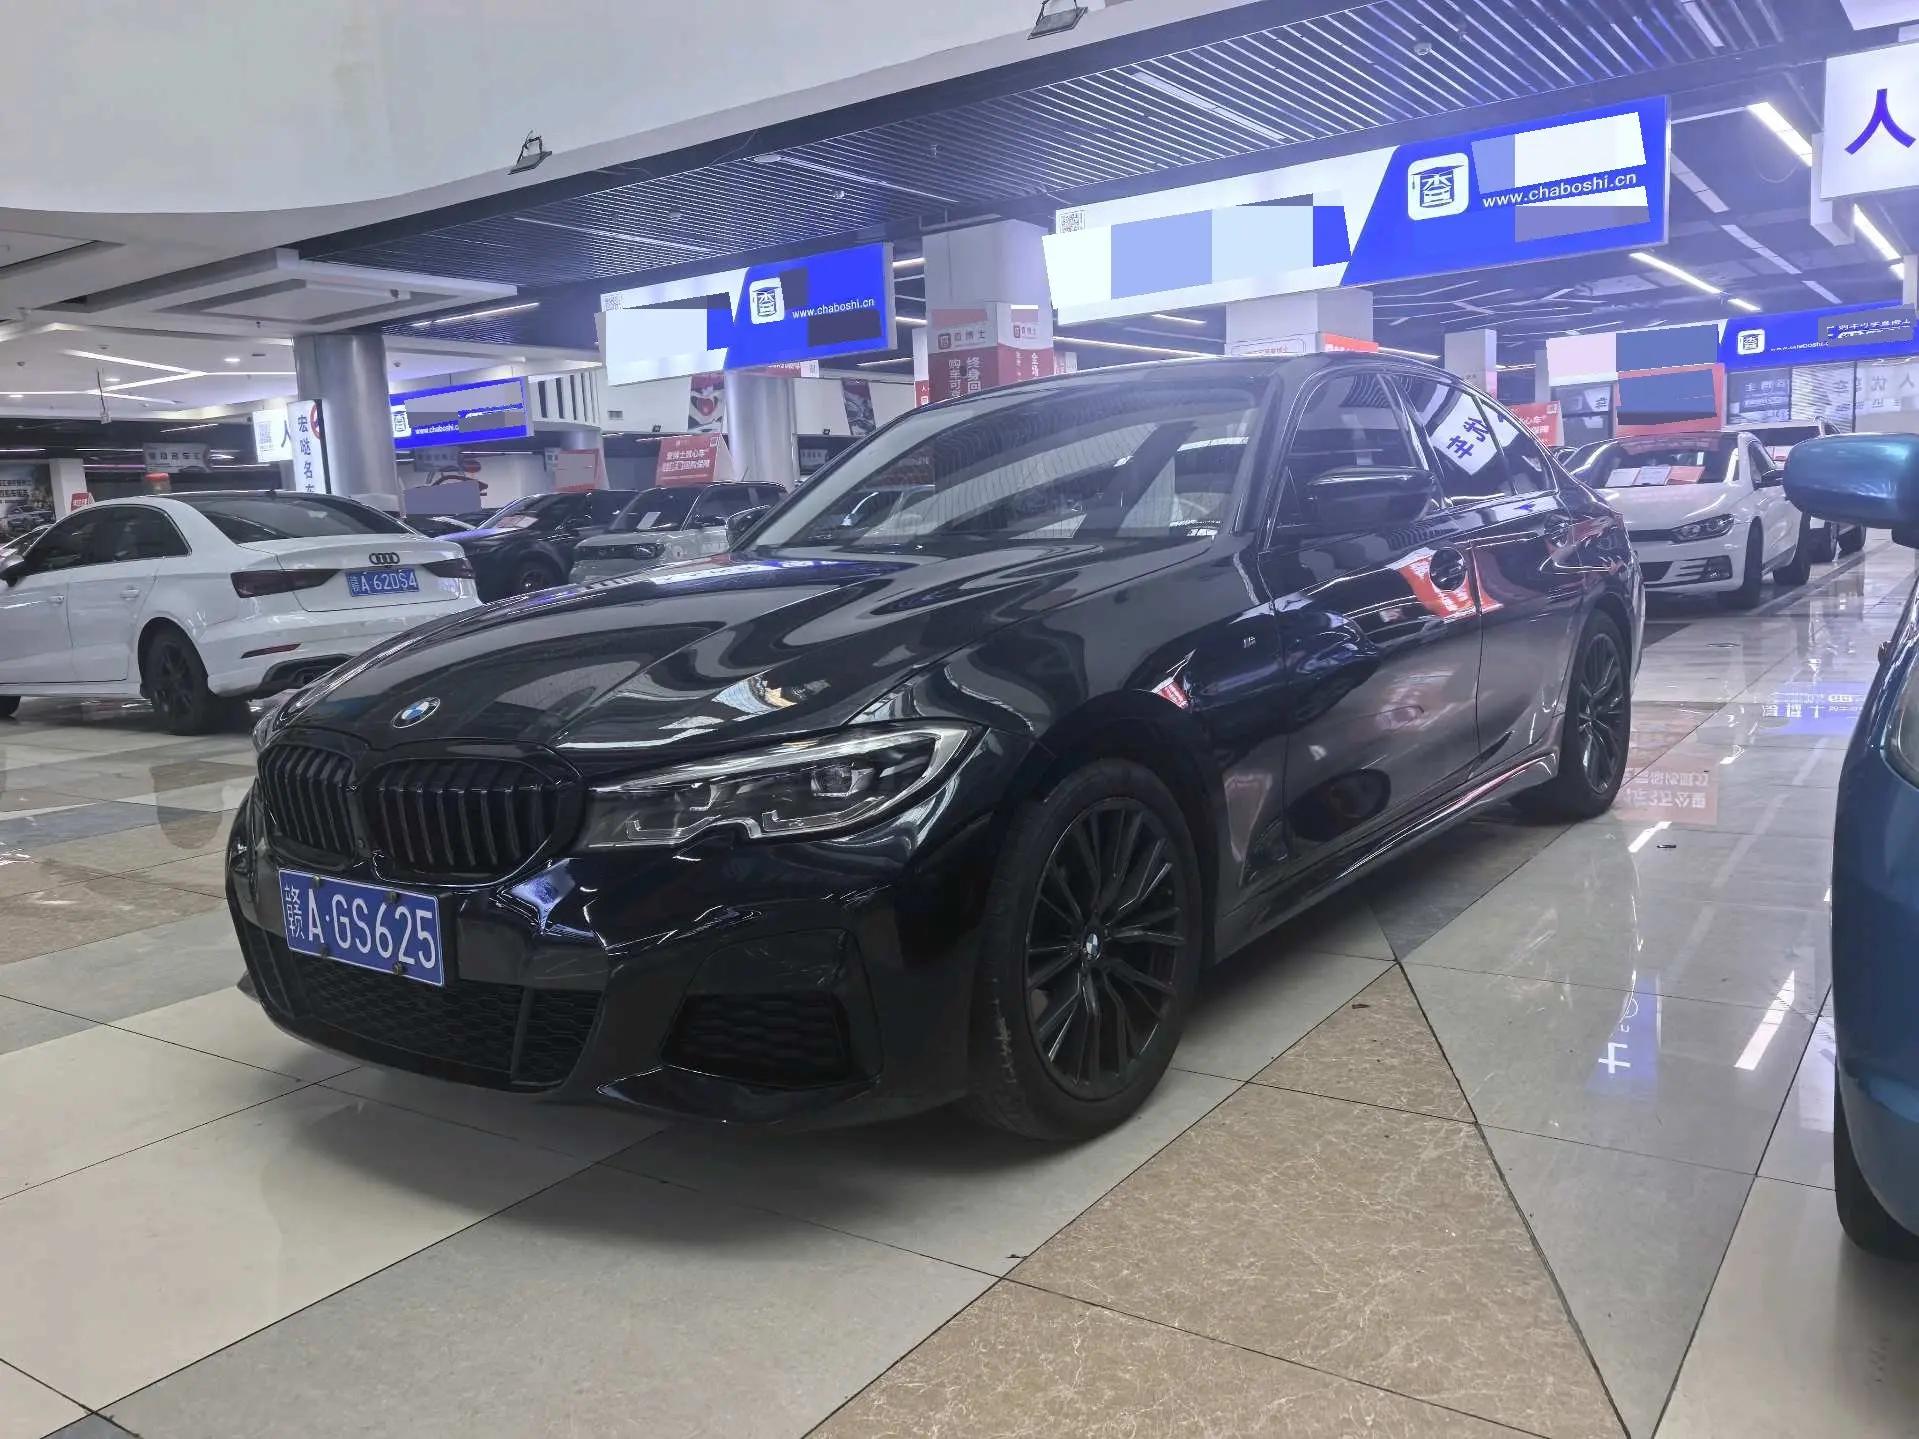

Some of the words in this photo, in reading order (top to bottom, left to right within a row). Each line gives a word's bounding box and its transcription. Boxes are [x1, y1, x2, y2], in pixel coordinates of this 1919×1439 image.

[1845, 88, 1917, 155] 人
[1483, 173, 1637, 208] www.chaboshi.cn
[792, 297, 875, 319] www.chaboshi.cn
